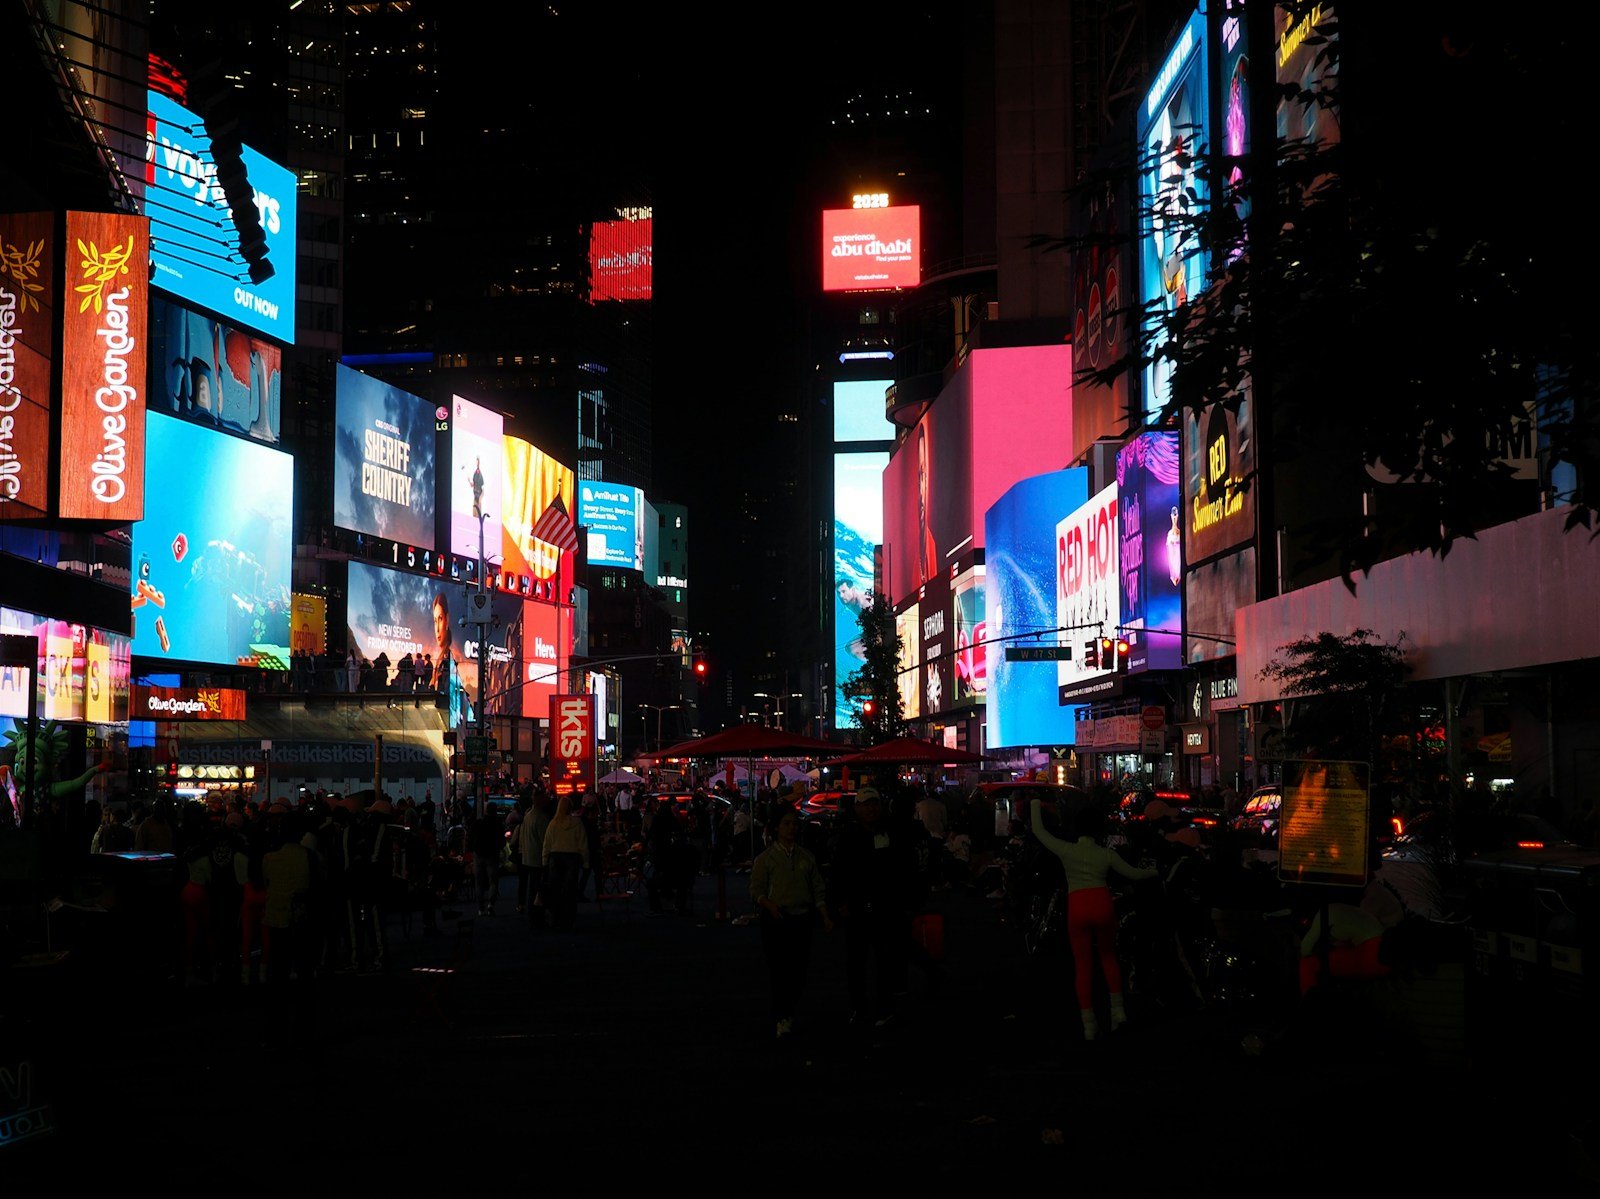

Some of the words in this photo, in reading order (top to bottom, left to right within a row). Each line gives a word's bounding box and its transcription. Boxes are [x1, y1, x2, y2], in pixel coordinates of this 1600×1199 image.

[831, 241, 862, 257] abu
[864, 238, 912, 255] dhabi
[832, 234, 876, 242] experience
[234, 287, 254, 309] OUT
[254, 296, 278, 320] NOW
[95, 286, 137, 412] Garden
[436, 422, 448, 431] LG
[91, 415, 126, 503] Olive
[365, 429, 410, 473] SHERIFF
[1209, 434, 1227, 486] RED
[362, 461, 412, 507] COUNTRY
[1193, 495, 1224, 534] Summer
[392, 543, 444, 574] 1540
[1059, 525, 1083, 601] RED
[1087, 499, 1117, 587] HOT
[379, 624, 393, 637] NEW
[393, 625, 412, 640] SERIES
[924, 610, 944, 641] SEPHORA
[368, 636, 389, 650] FRIDAY
[389, 639, 416, 654] OCTOBER
[1021, 650, 1028, 659] W
[1033, 650, 1043, 659] 47
[1048, 650, 1056, 659] St
[1211, 680, 1226, 699] BLUE
[1228, 678, 1238, 697] FIN
[149, 696, 169, 710] Olive
[169, 698, 207, 714] Garden
[561, 698, 588, 758] tkts
